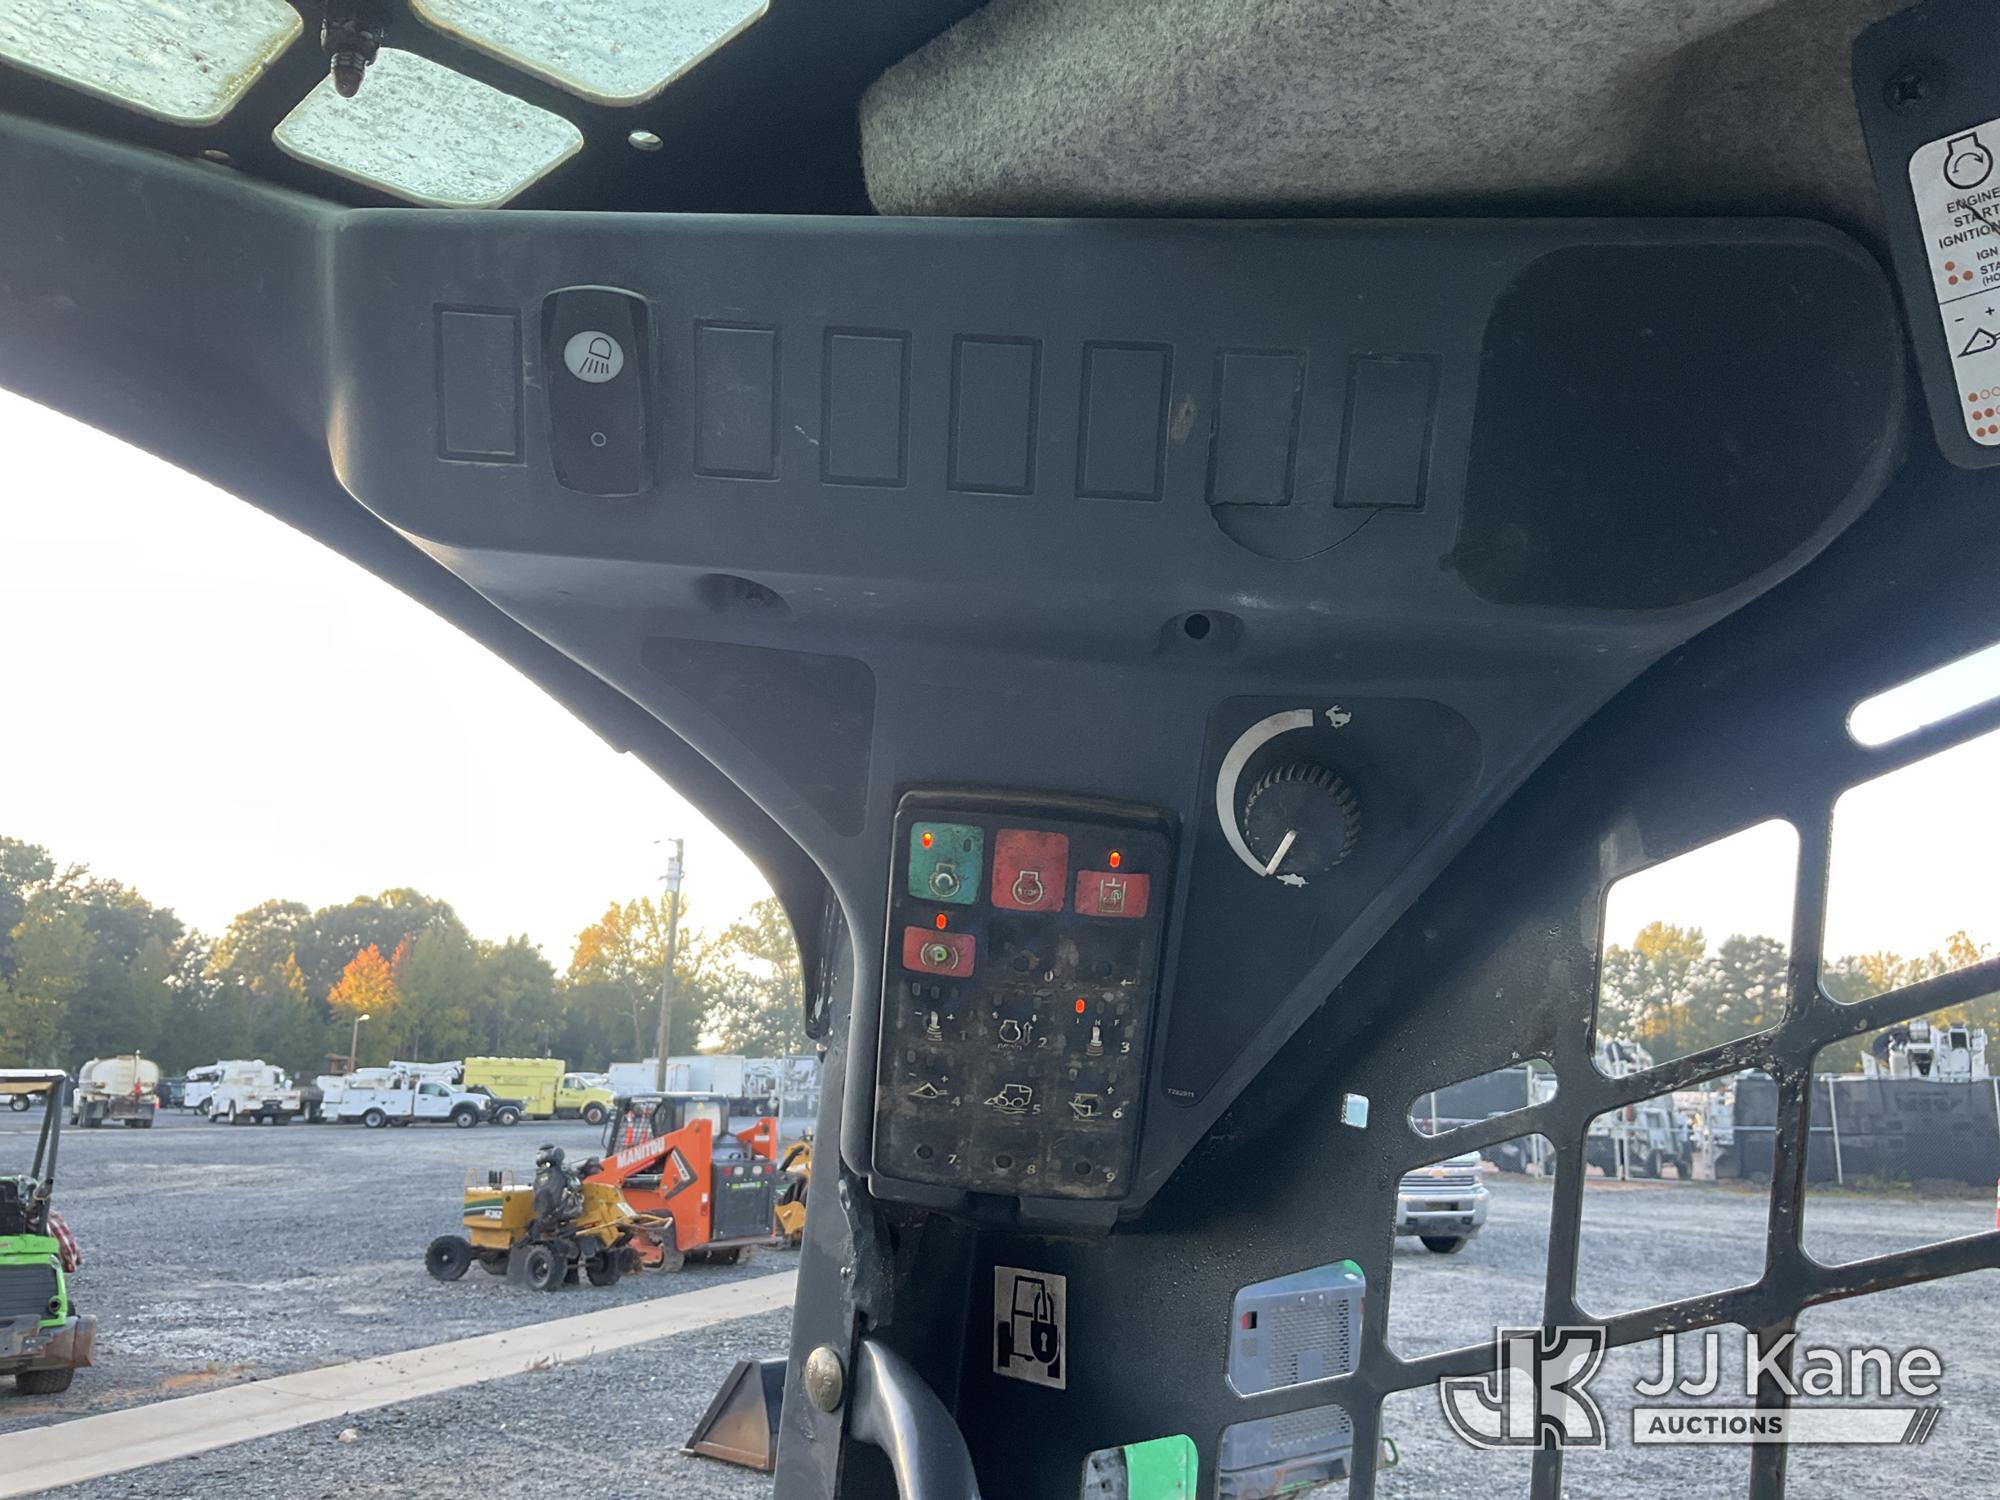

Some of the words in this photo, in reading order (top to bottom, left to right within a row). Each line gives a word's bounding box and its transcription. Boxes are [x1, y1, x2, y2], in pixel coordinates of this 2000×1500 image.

[1946, 187, 2000, 214] ENGINE
[1954, 203, 2000, 228] START
[1938, 220, 2000, 249] IGNITION
[1976, 246, 1999, 261] IGN
[1038, 1037, 1048, 1049] 2
[1120, 1041, 1131, 1053] 3
[951, 1096, 961, 1107] 4
[1031, 1103, 1041, 1115] 5
[1112, 1108, 1122, 1119] 6
[616, 1137, 666, 1169] MANITOU
[948, 1154, 957, 1164] 7
[1026, 1164, 1036, 1175] 8
[1106, 1171, 1115, 1183] 9
